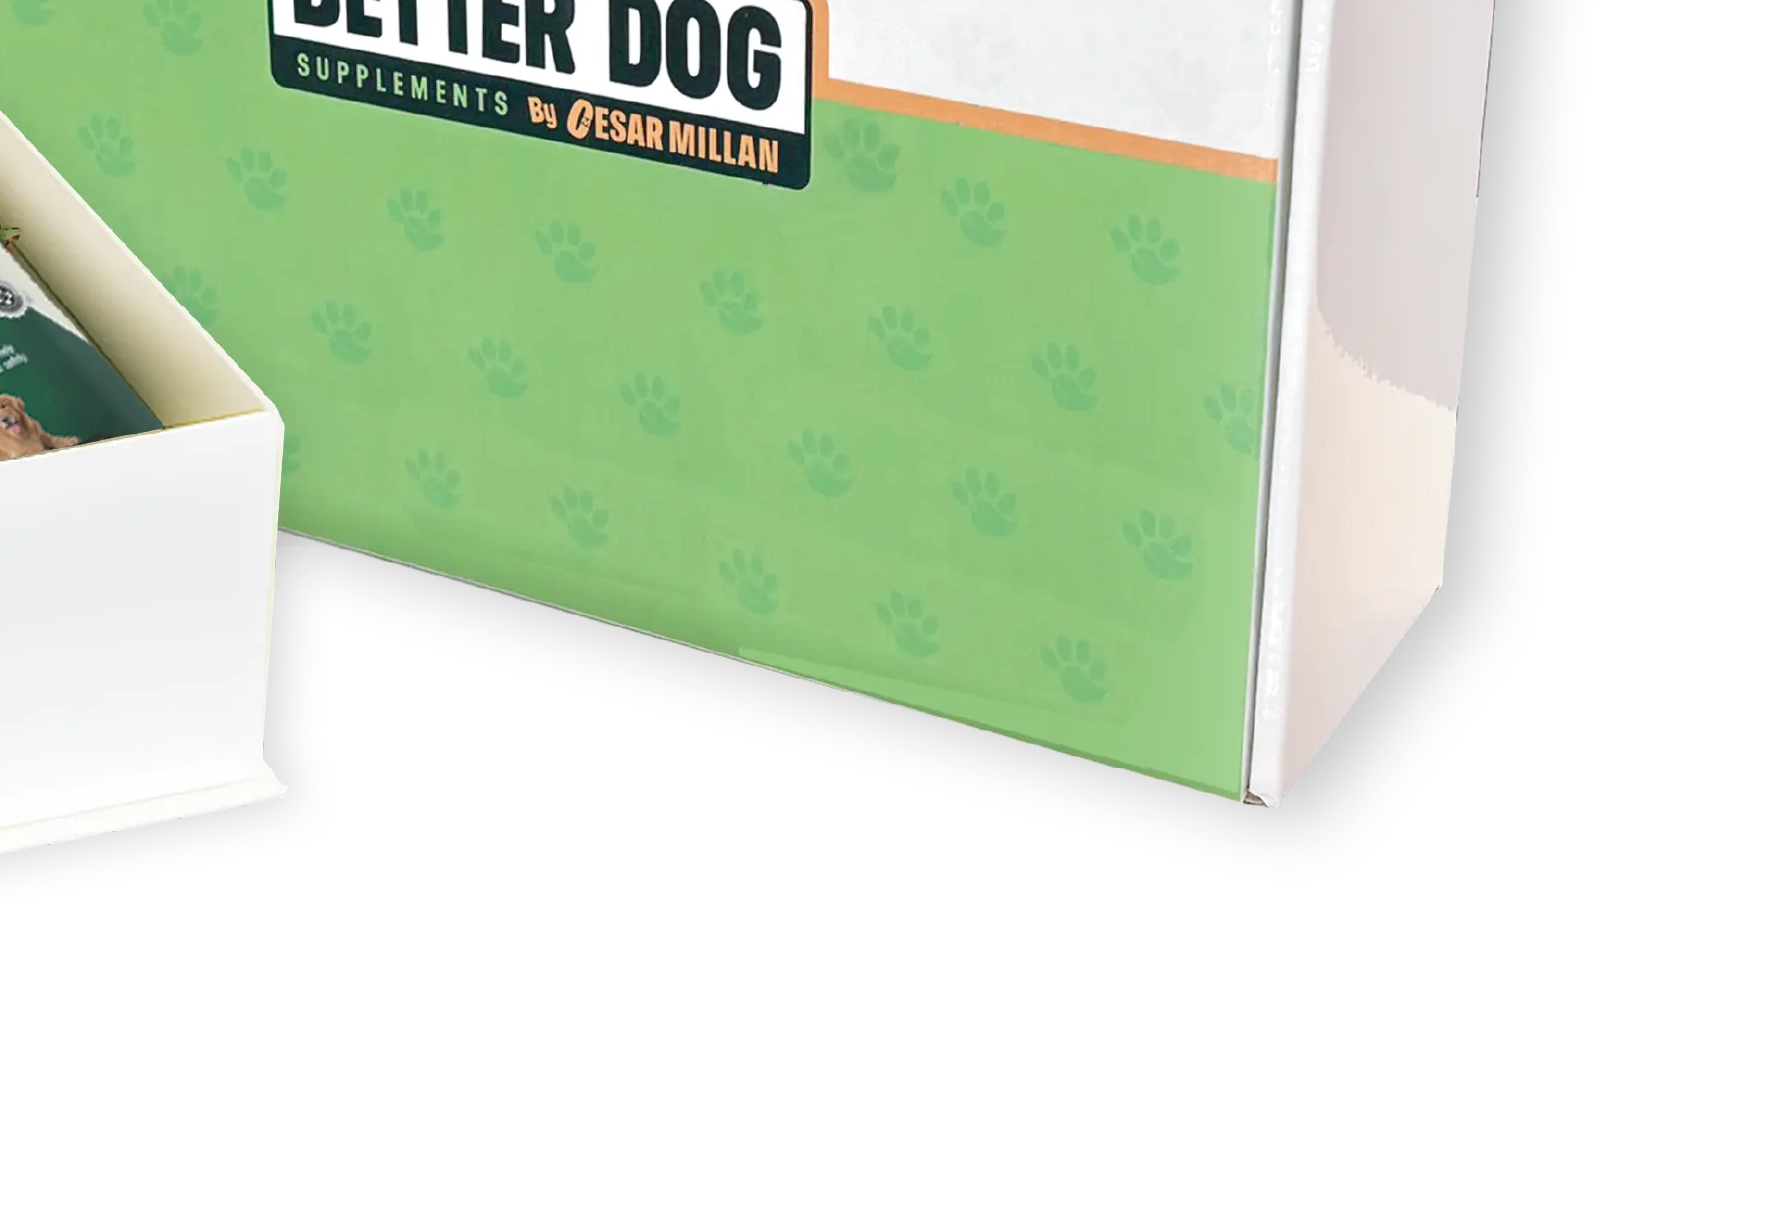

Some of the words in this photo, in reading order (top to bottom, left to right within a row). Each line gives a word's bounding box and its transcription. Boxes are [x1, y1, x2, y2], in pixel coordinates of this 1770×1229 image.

[296, 53, 508, 116] SUPPLEMENTS
[527, 96, 558, 130] By
[566, 98, 664, 152] CESAR
[669, 121, 779, 174] MILLAN
